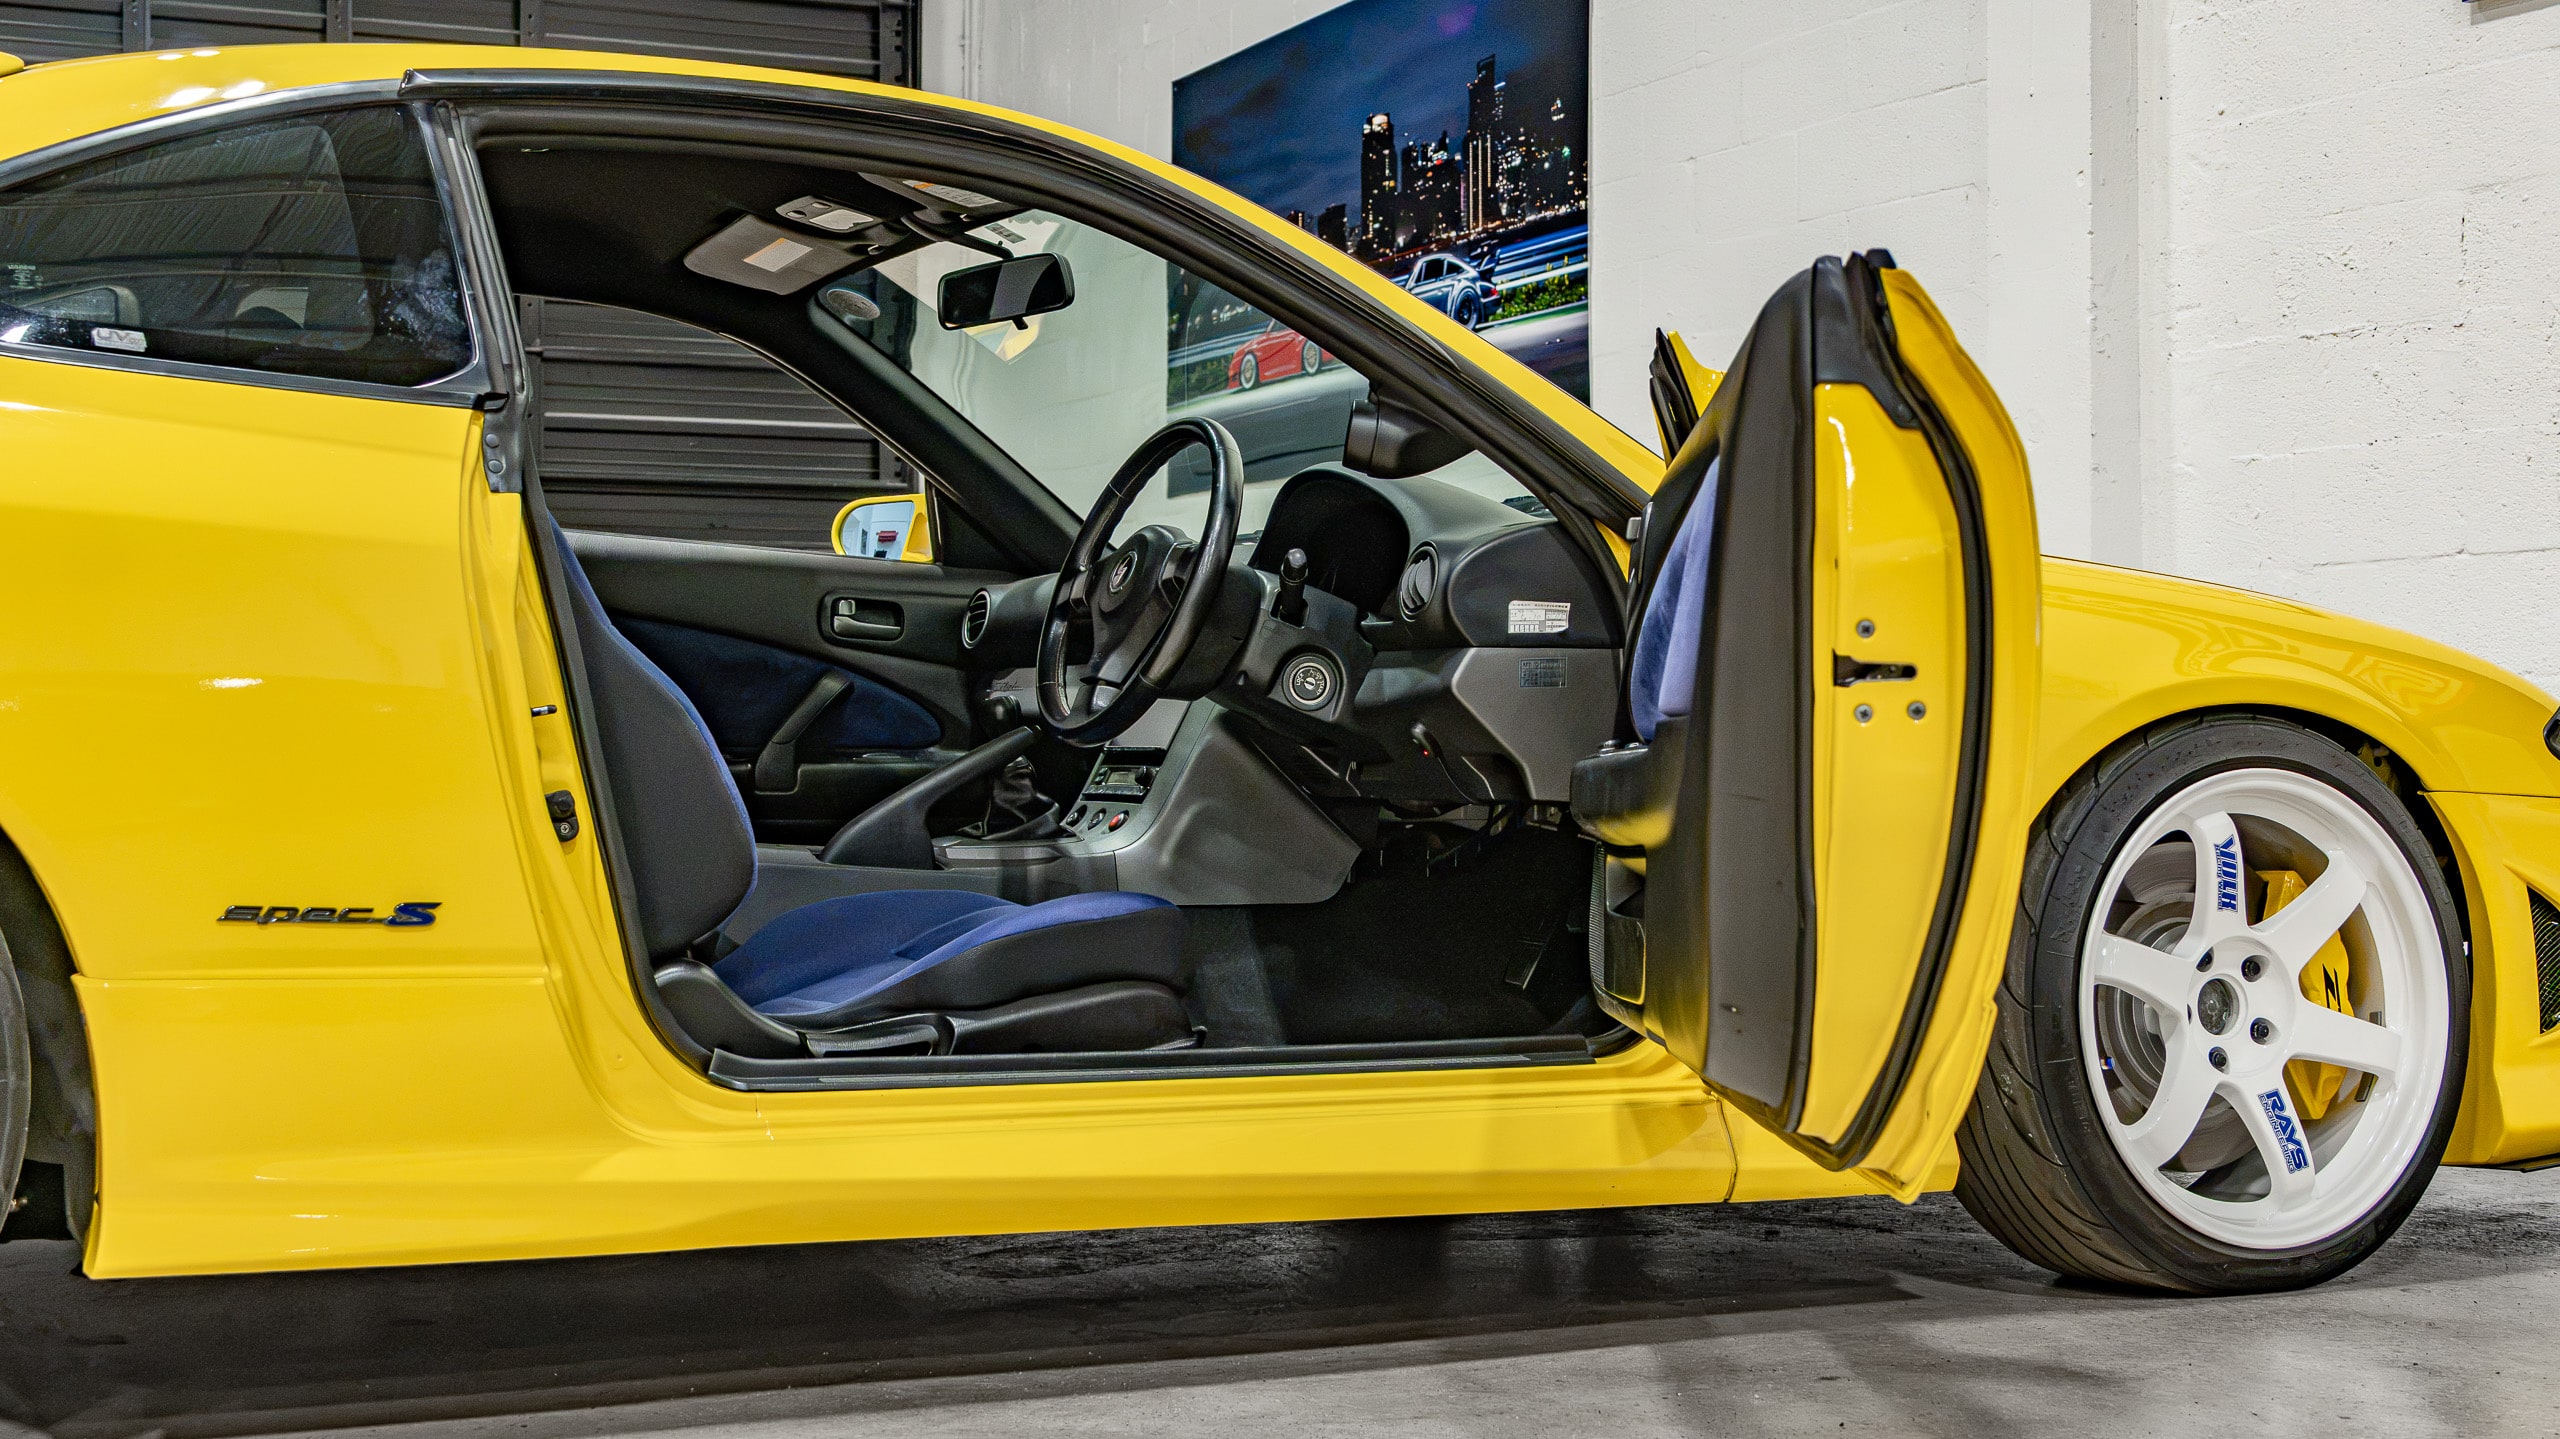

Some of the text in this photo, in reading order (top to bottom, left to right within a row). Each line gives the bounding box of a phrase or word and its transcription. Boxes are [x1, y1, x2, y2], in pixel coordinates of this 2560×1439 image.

[2219, 834, 2238, 913] VOLK
[216, 902, 442, 927] spec S
[2258, 1094, 2295, 1174] ENGINEERING
[2264, 1089, 2309, 1171] RAYS
